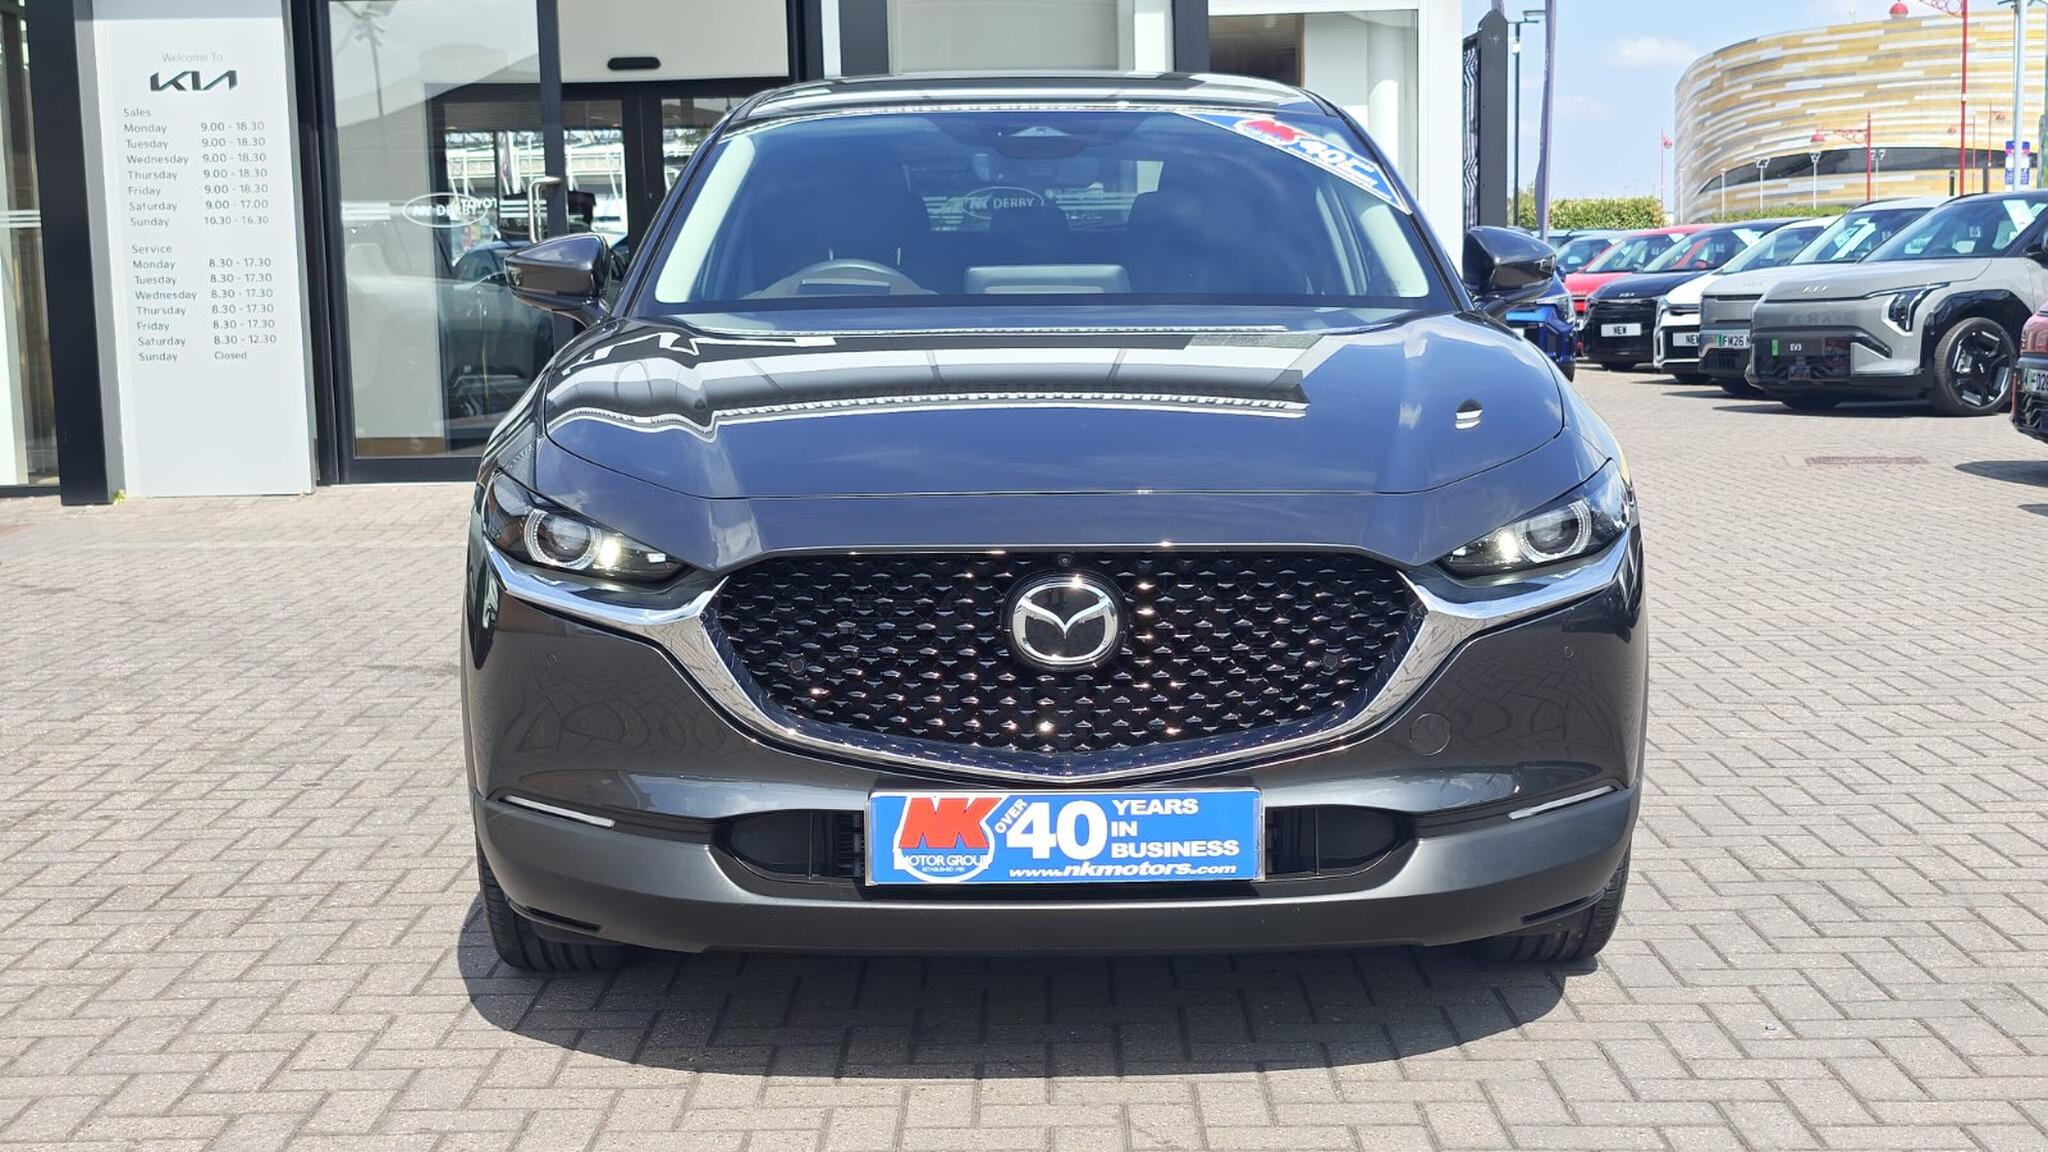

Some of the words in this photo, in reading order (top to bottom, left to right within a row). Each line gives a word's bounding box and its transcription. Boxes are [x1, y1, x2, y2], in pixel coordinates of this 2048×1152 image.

[162, 54, 207, 62] Welcome
[211, 52, 223, 61] To
[150, 70, 237, 91] KIA
[124, 108, 151, 117] Sales
[124, 124, 166, 134] Monday
[201, 122, 224, 132] 9.00
[236, 122, 264, 130] 18.30
[126, 139, 168, 150] Tuesday
[202, 138, 226, 147] 9.00
[237, 137, 265, 146] 18.30
[127, 155, 188, 164] Wednesday
[202, 153, 227, 163] 9.00
[238, 153, 266, 162] 18.30
[128, 170, 177, 181] Thursday
[204, 169, 227, 178] 9.00
[239, 168, 267, 177] 18.30
[128, 186, 161, 196] Friday
[205, 185, 228, 193] 9.00
[240, 184, 268, 193] 18.30
[130, 202, 177, 212] Saturday
[206, 200, 229, 209] 9.00
[240, 200, 268, 208] 17.00
[131, 217, 169, 227] Sunday
[205, 216, 231, 225] 10.30
[242, 216, 268, 224] 16.30
[132, 245, 171, 254] Service
[133, 260, 175, 270] Monday
[209, 258, 233, 267] 8.30
[244, 258, 271, 267] 17.30
[135, 276, 176, 285] Tuesday
[210, 274, 233, 283] 8.30
[245, 273, 272, 282] 17.30
[135, 291, 196, 300] Wednesday
[211, 289, 235, 299] 8.30
[246, 289, 273, 297] 17.30
[136, 306, 185, 316] Thursday
[212, 304, 236, 314] 8.30
[247, 304, 273, 312] 17.30
[137, 322, 169, 332] Friday
[213, 320, 236, 329] 8.30
[248, 320, 275, 328] 17.30
[1613, 326, 1627, 335] NEW
[138, 336, 185, 347] Saturday
[214, 336, 237, 344] 8.30
[249, 335, 276, 344] 12.30
[139, 352, 177, 361] Sunday
[1111, 798, 1199, 816] YEARS
[995, 798, 1028, 833] OVER
[899, 797, 1001, 849] NK
[1111, 821, 1138, 837] IN
[1006, 800, 1107, 861] 40
[1111, 840, 1240, 859] BUSINESS
[1009, 861, 1237, 878] www.nkmotors.com
